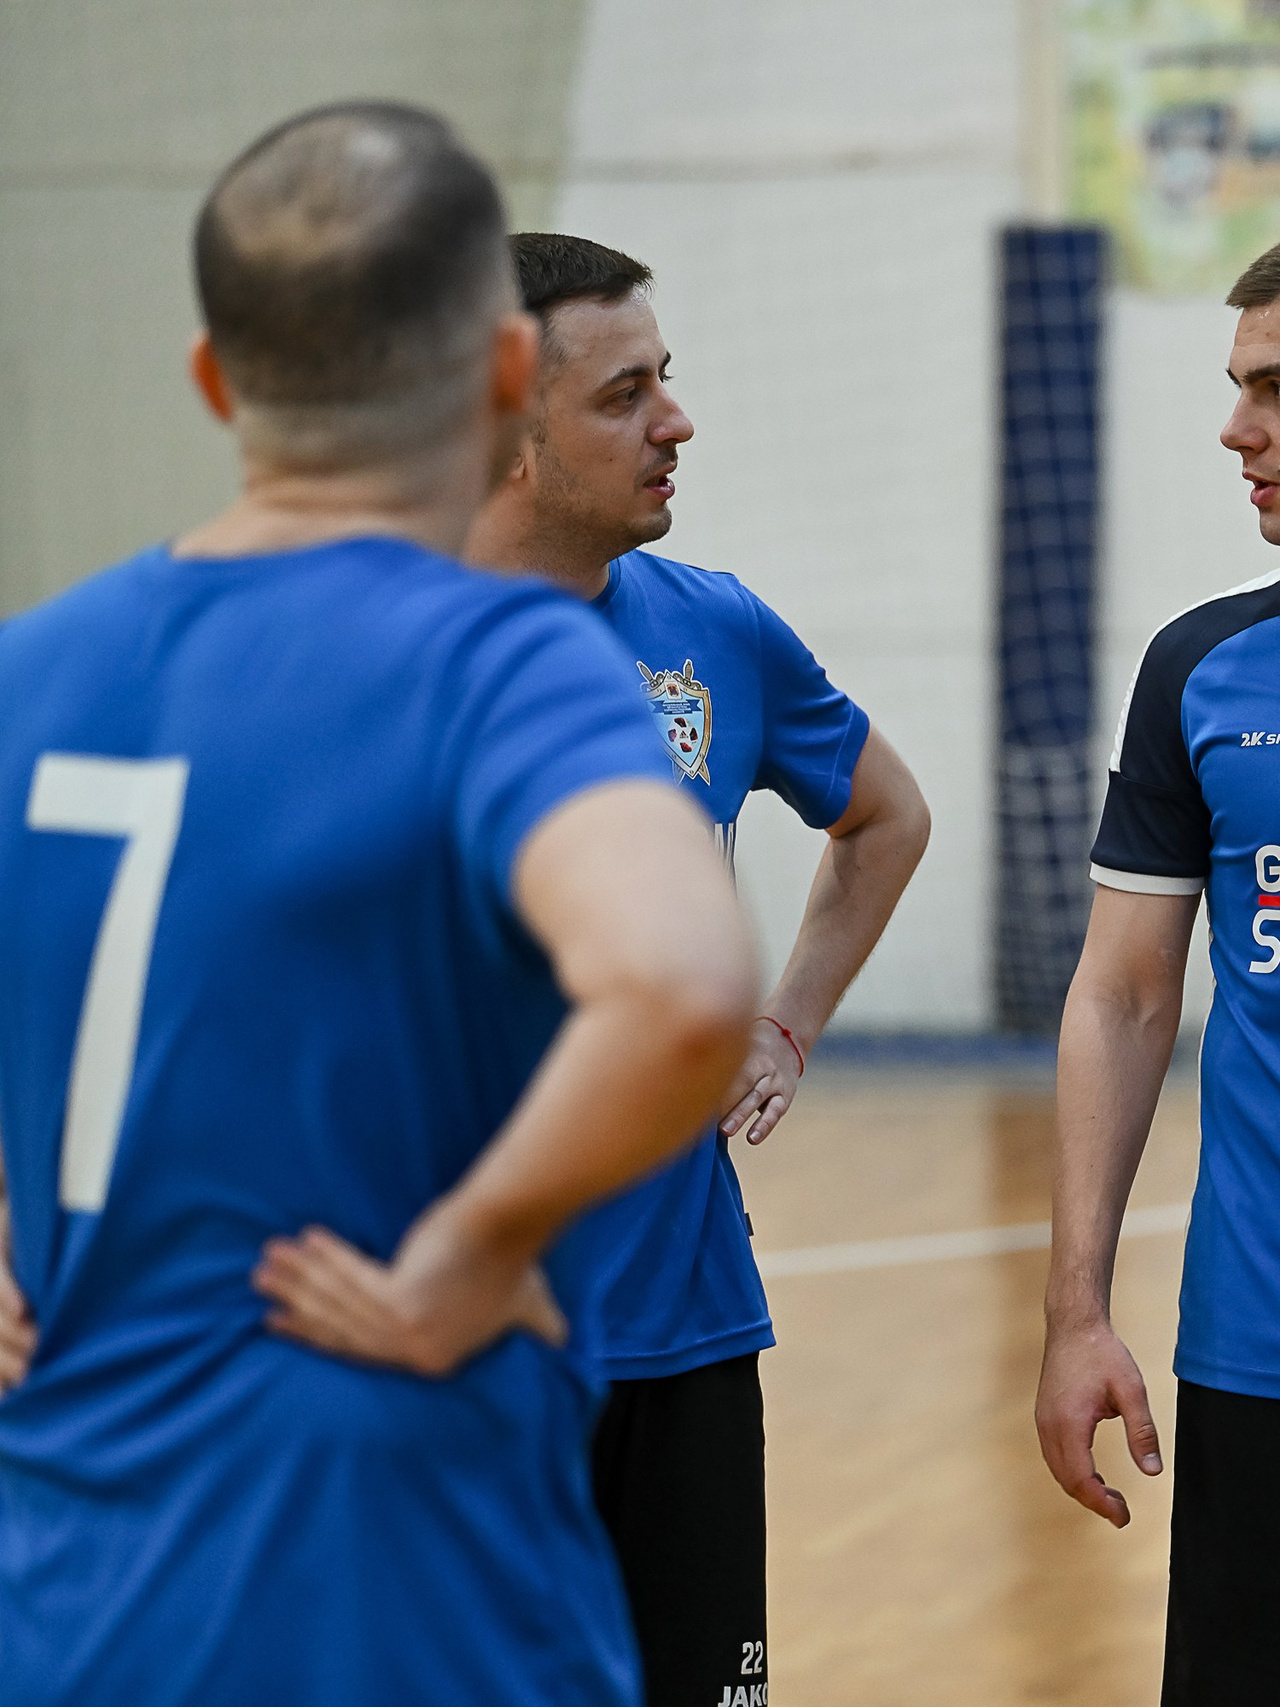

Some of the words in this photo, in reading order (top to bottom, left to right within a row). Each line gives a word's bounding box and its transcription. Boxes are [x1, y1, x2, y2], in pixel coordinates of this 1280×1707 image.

[1241, 732, 1265, 747] 2K
[26, 752, 190, 1214] 7
[741, 1641, 764, 1675] 22
